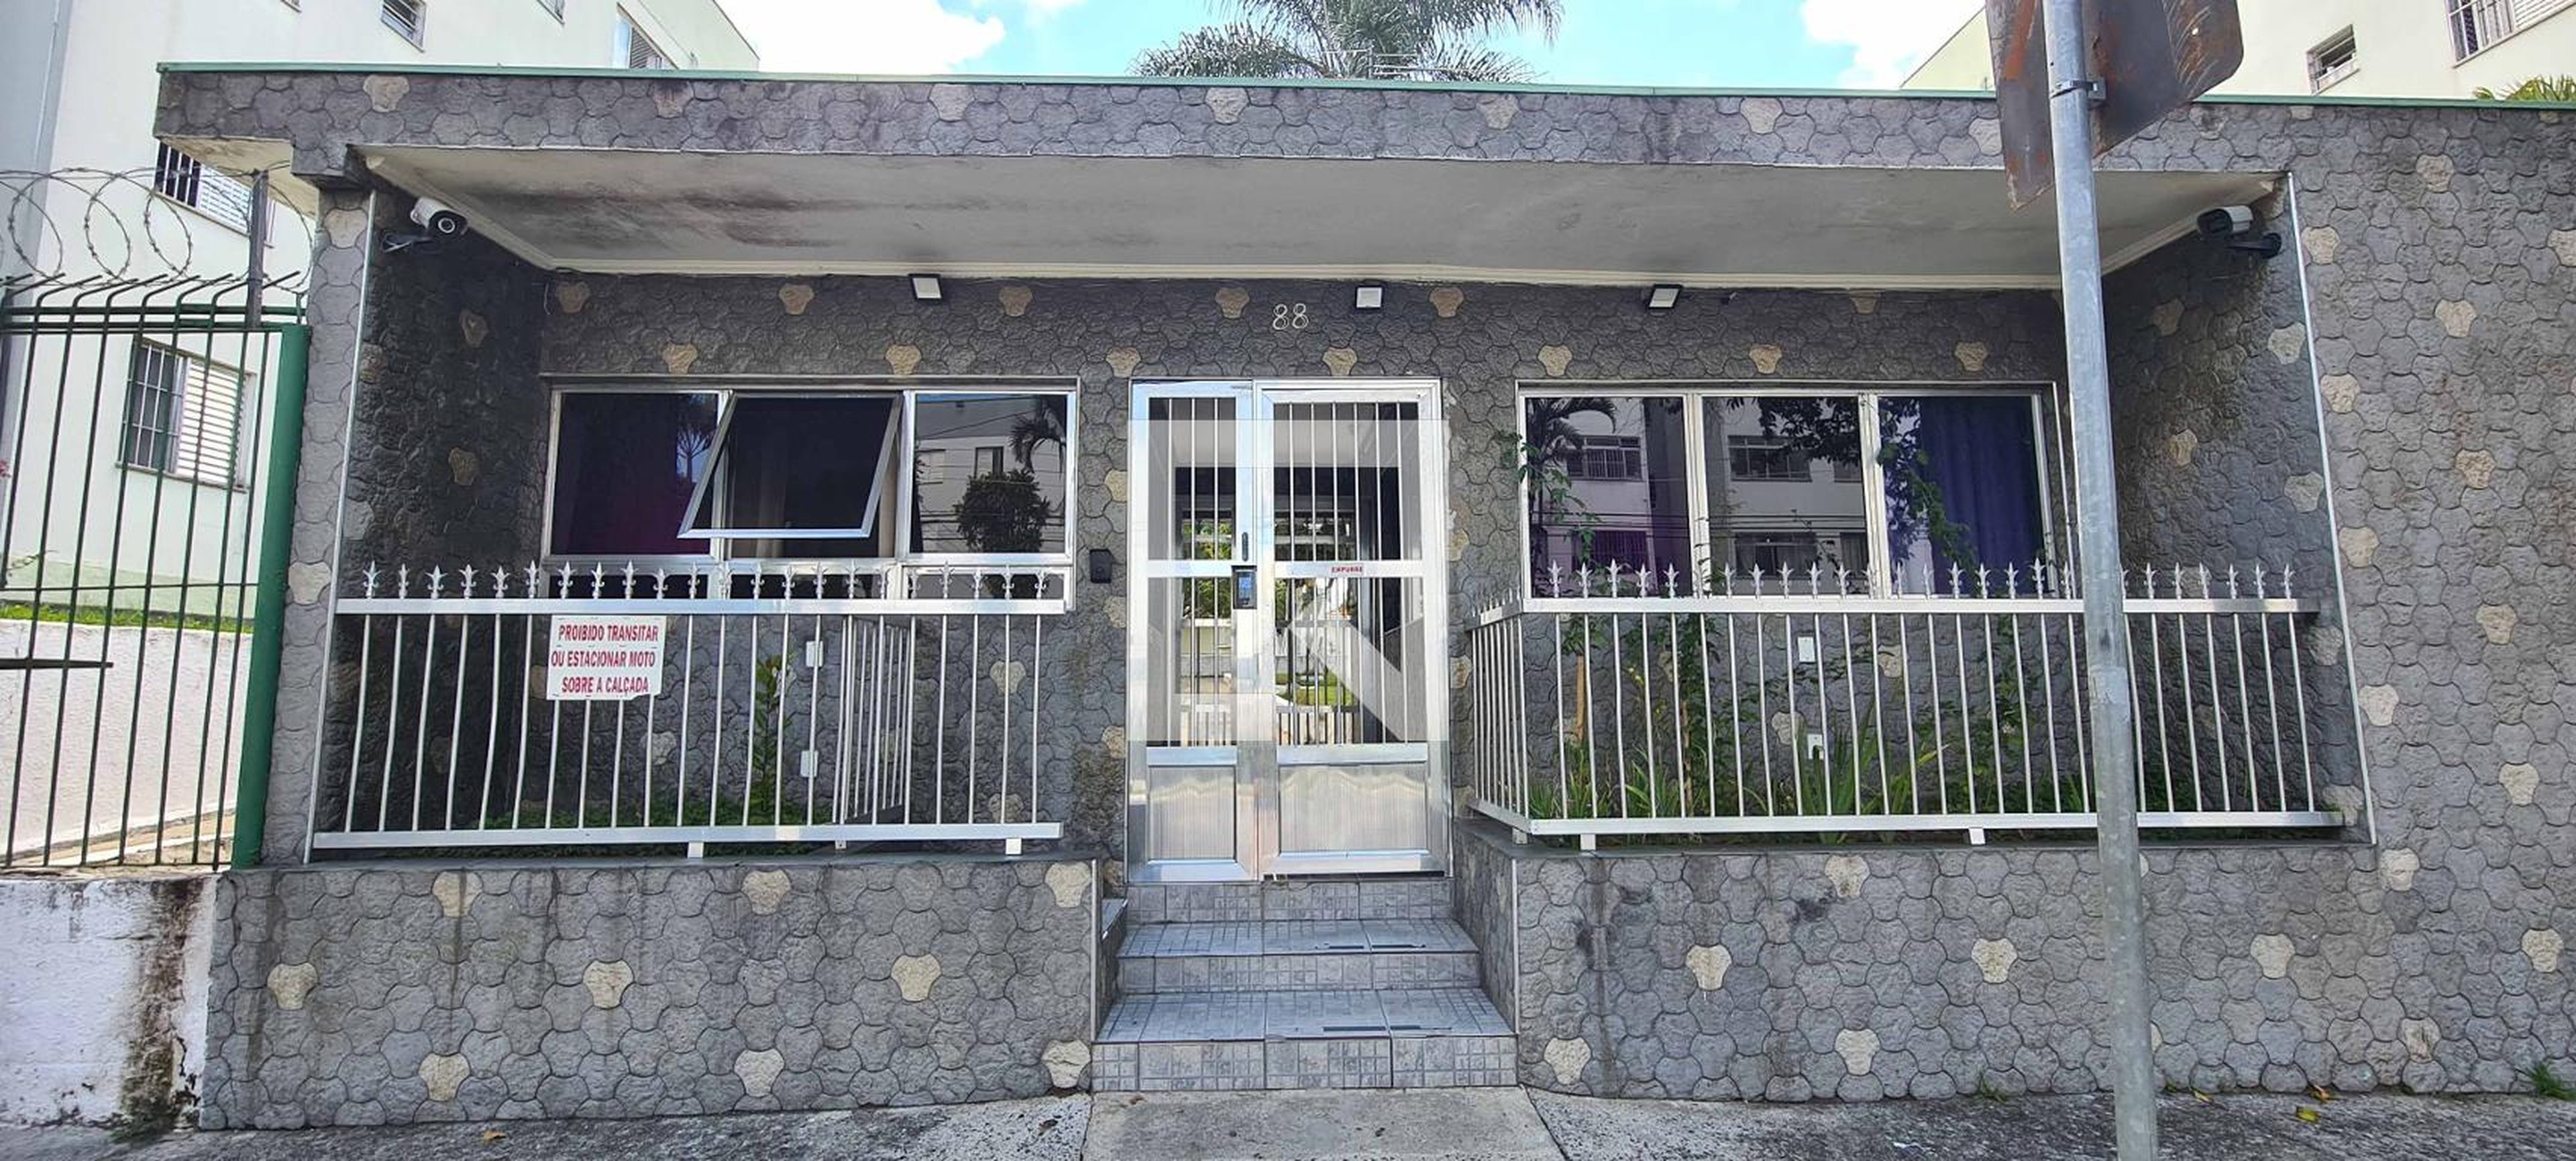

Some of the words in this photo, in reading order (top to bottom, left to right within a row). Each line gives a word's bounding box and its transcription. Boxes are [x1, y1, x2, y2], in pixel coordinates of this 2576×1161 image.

[1273, 303, 1309, 330] 88
[559, 625, 603, 641] PROIBIDO
[607, 625, 658, 642] TRANSITAR
[551, 651, 565, 667] OU
[567, 651, 627, 668] ESTACIONAR
[629, 652, 655, 668] MOTO
[562, 676, 594, 693] SOBRE
[596, 677, 602, 693] A
[606, 676, 649, 695] CALÇADA
